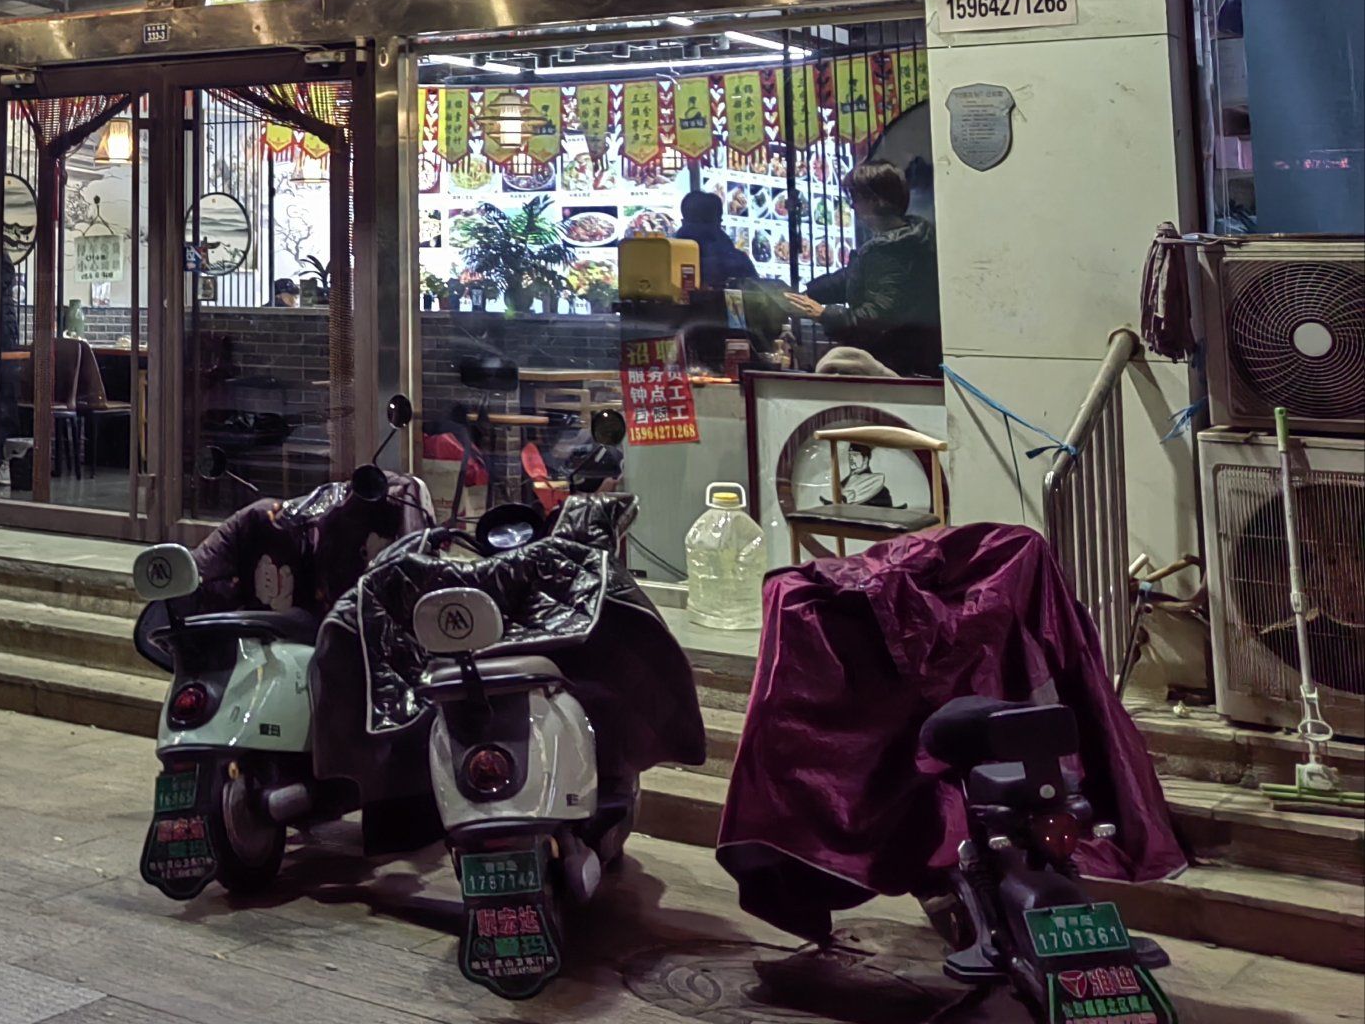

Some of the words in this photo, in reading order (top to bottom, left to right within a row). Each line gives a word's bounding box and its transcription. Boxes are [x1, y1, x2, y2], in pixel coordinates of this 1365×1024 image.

[627, 339, 678, 366] 招聘
[628, 364, 684, 384] 服务员
[630, 385, 687, 404] 钟点工
[629, 423, 696, 442] 15964271268
[1038, 925, 1121, 950] 1701361
